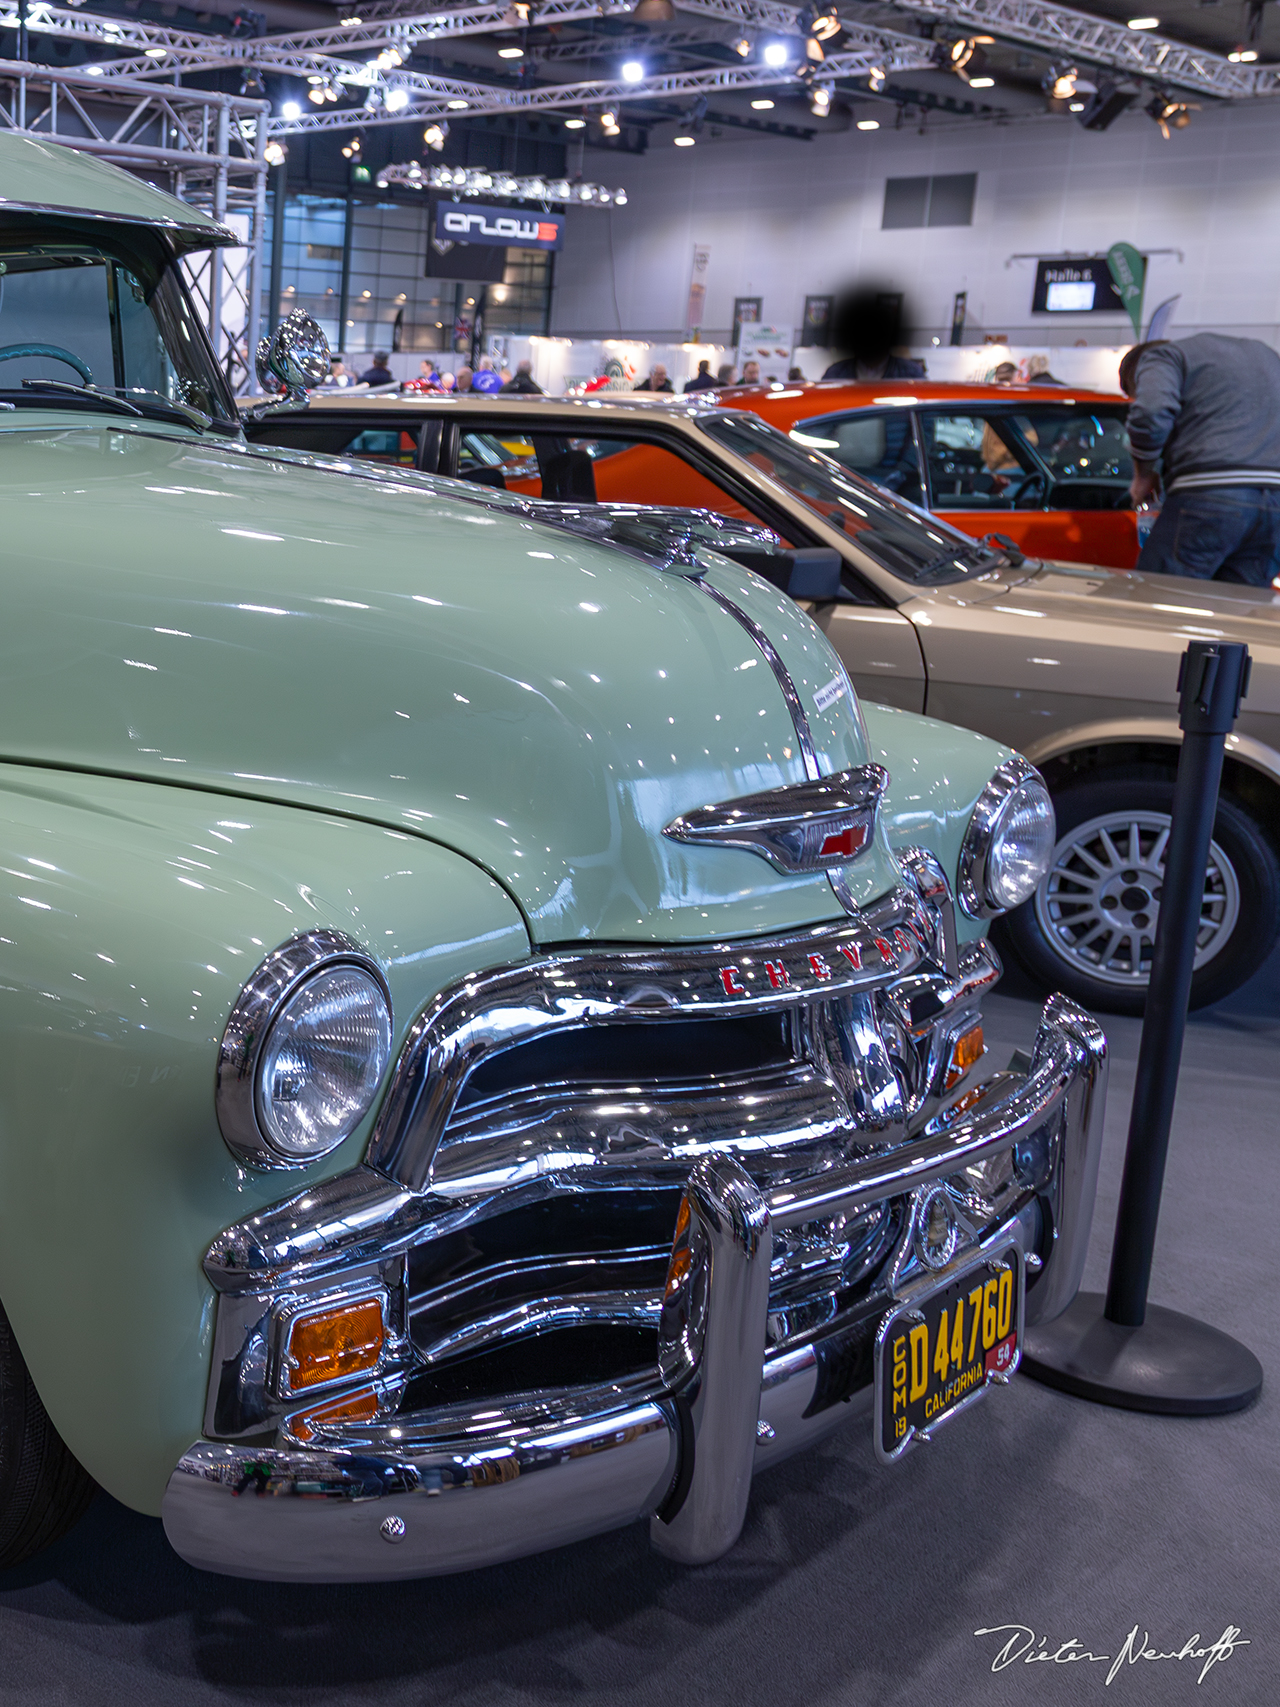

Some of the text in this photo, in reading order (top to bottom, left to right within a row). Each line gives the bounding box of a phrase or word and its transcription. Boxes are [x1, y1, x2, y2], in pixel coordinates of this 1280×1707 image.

[1045, 268, 1081, 283] Halle
[893, 1335, 907, 1415] COM
[925, 1362, 983, 1419] CALIFORNIA
[894, 1416, 907, 1439] 19
